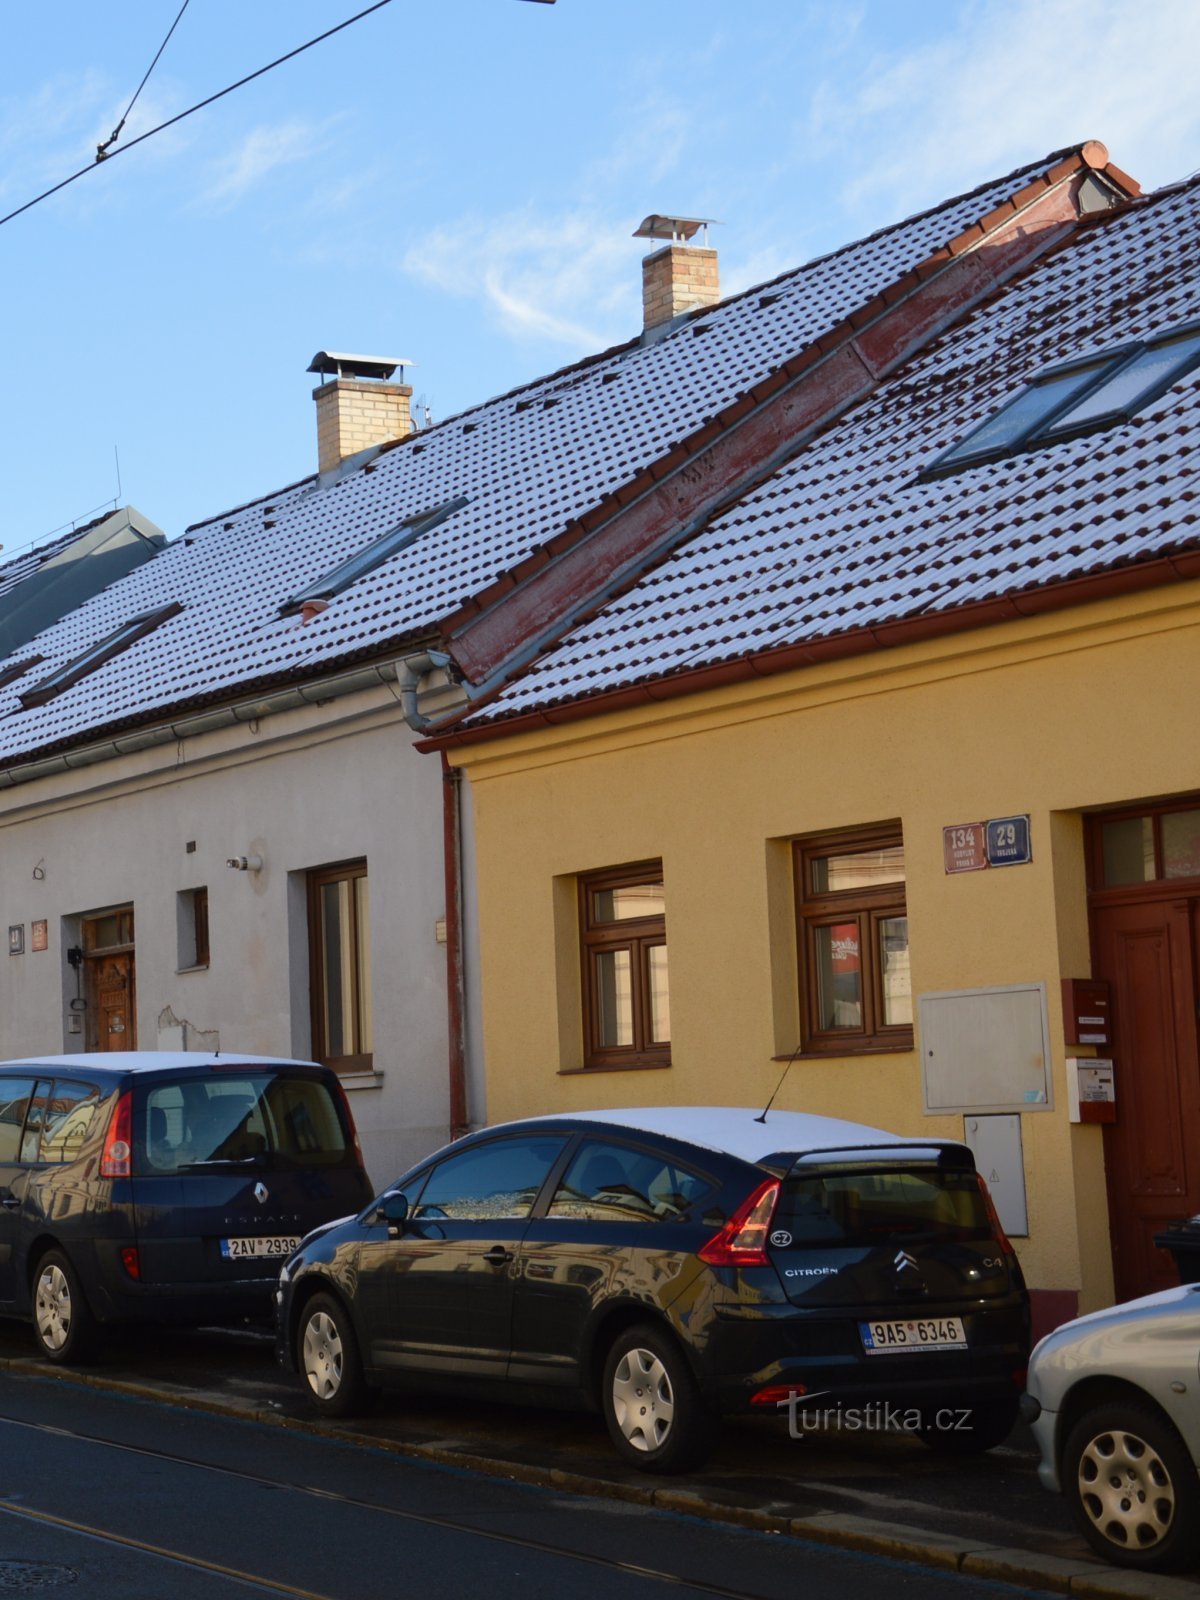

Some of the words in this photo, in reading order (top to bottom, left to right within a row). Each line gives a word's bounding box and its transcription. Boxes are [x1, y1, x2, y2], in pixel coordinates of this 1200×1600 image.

[951, 828, 975, 849] 134
[996, 823, 1016, 847] 29
[231, 1240, 255, 1255] 2AV
[266, 1239, 297, 1254] 2939
[773, 1234, 788, 1244] CZ
[875, 1323, 907, 1344] 9A5
[917, 1321, 957, 1341] 6346
